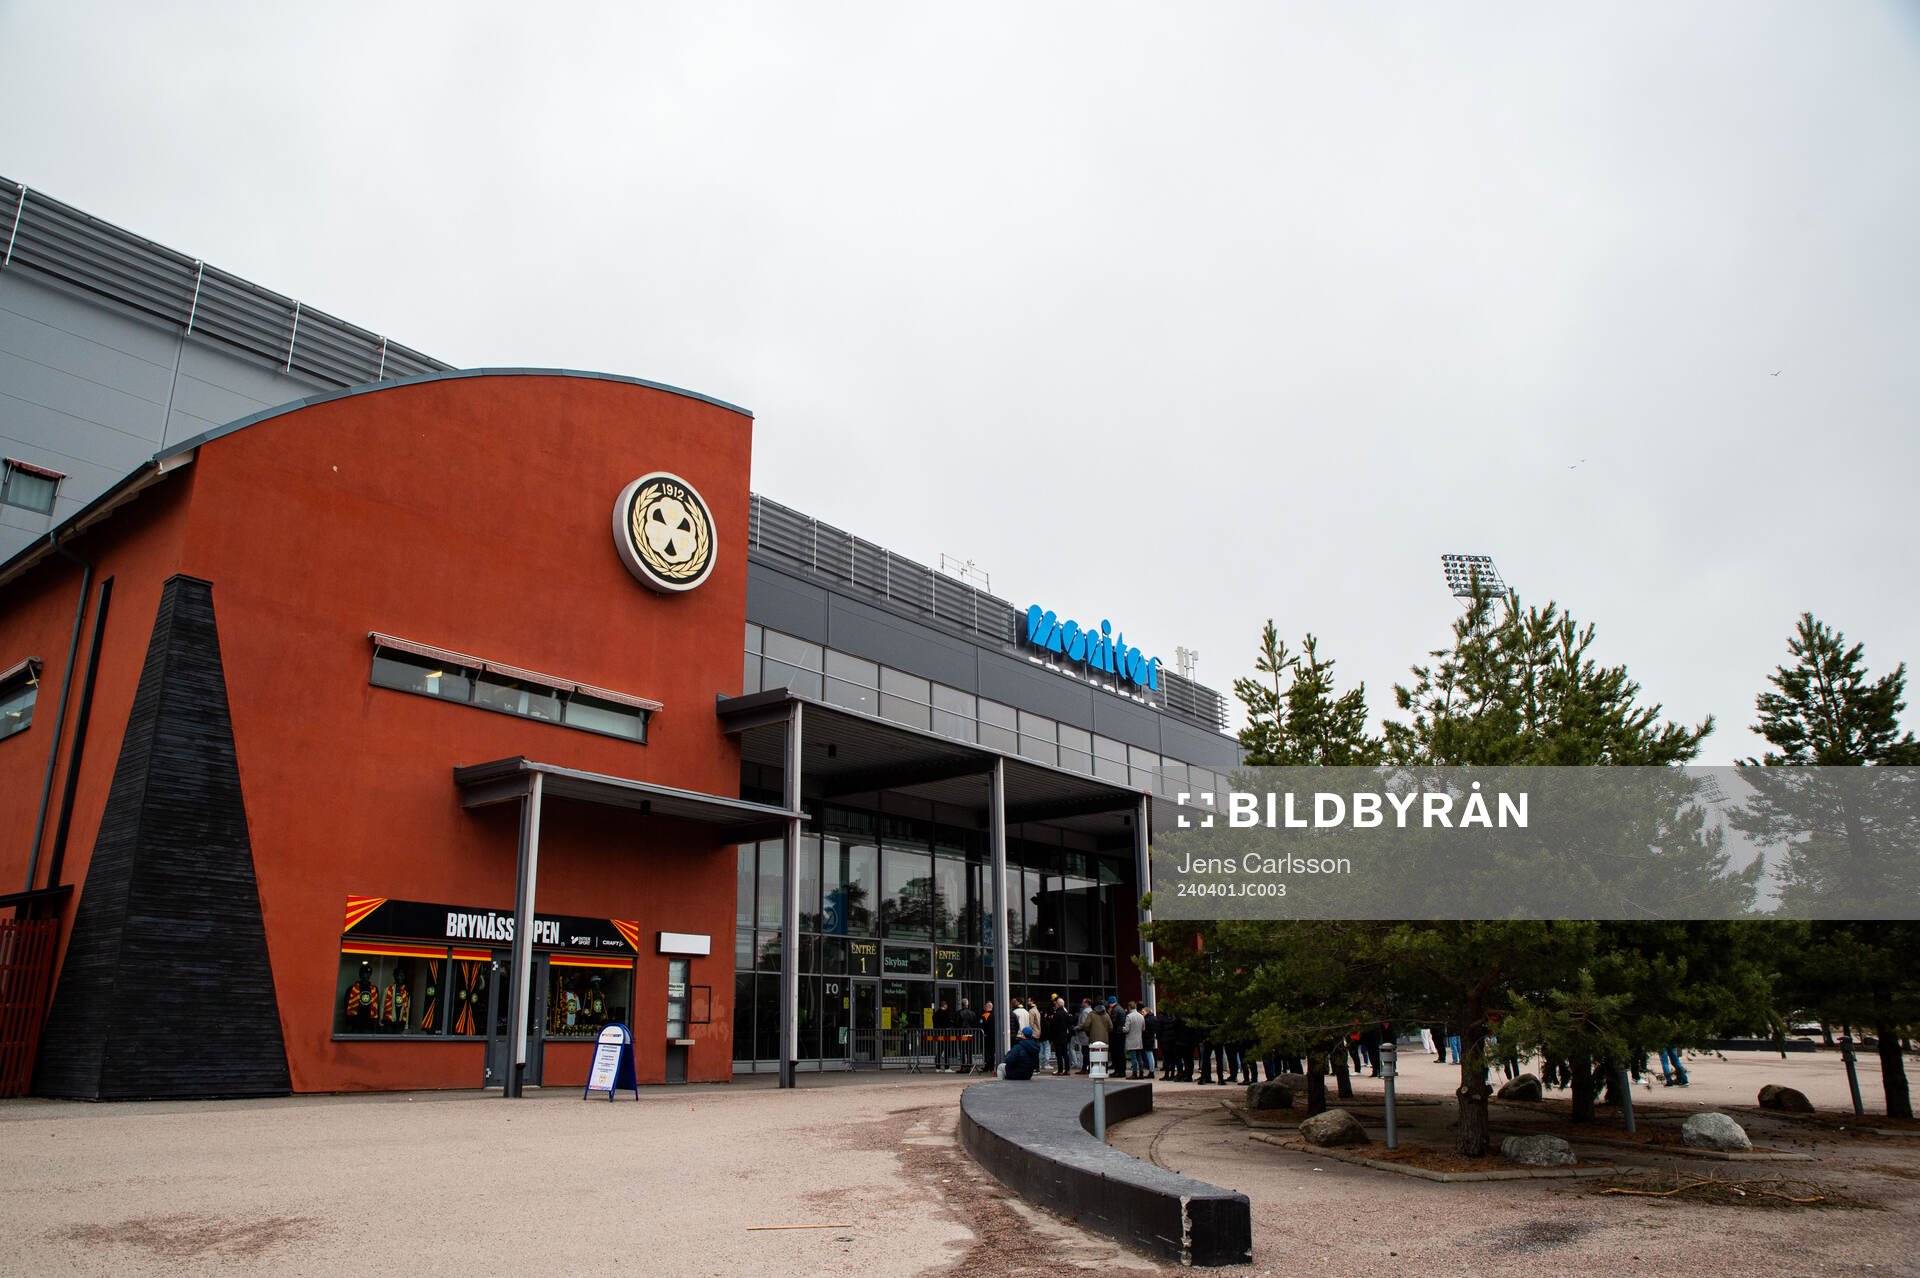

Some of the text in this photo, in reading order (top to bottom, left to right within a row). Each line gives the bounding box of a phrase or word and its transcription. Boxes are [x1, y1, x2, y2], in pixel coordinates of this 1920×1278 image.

[662, 483, 685, 501] 1912
[446, 912, 560, 945] BRYNÄSSPEN
[860, 957, 867, 974] 1
[884, 956, 908, 968] Skybar
[946, 962, 953, 978] 2
